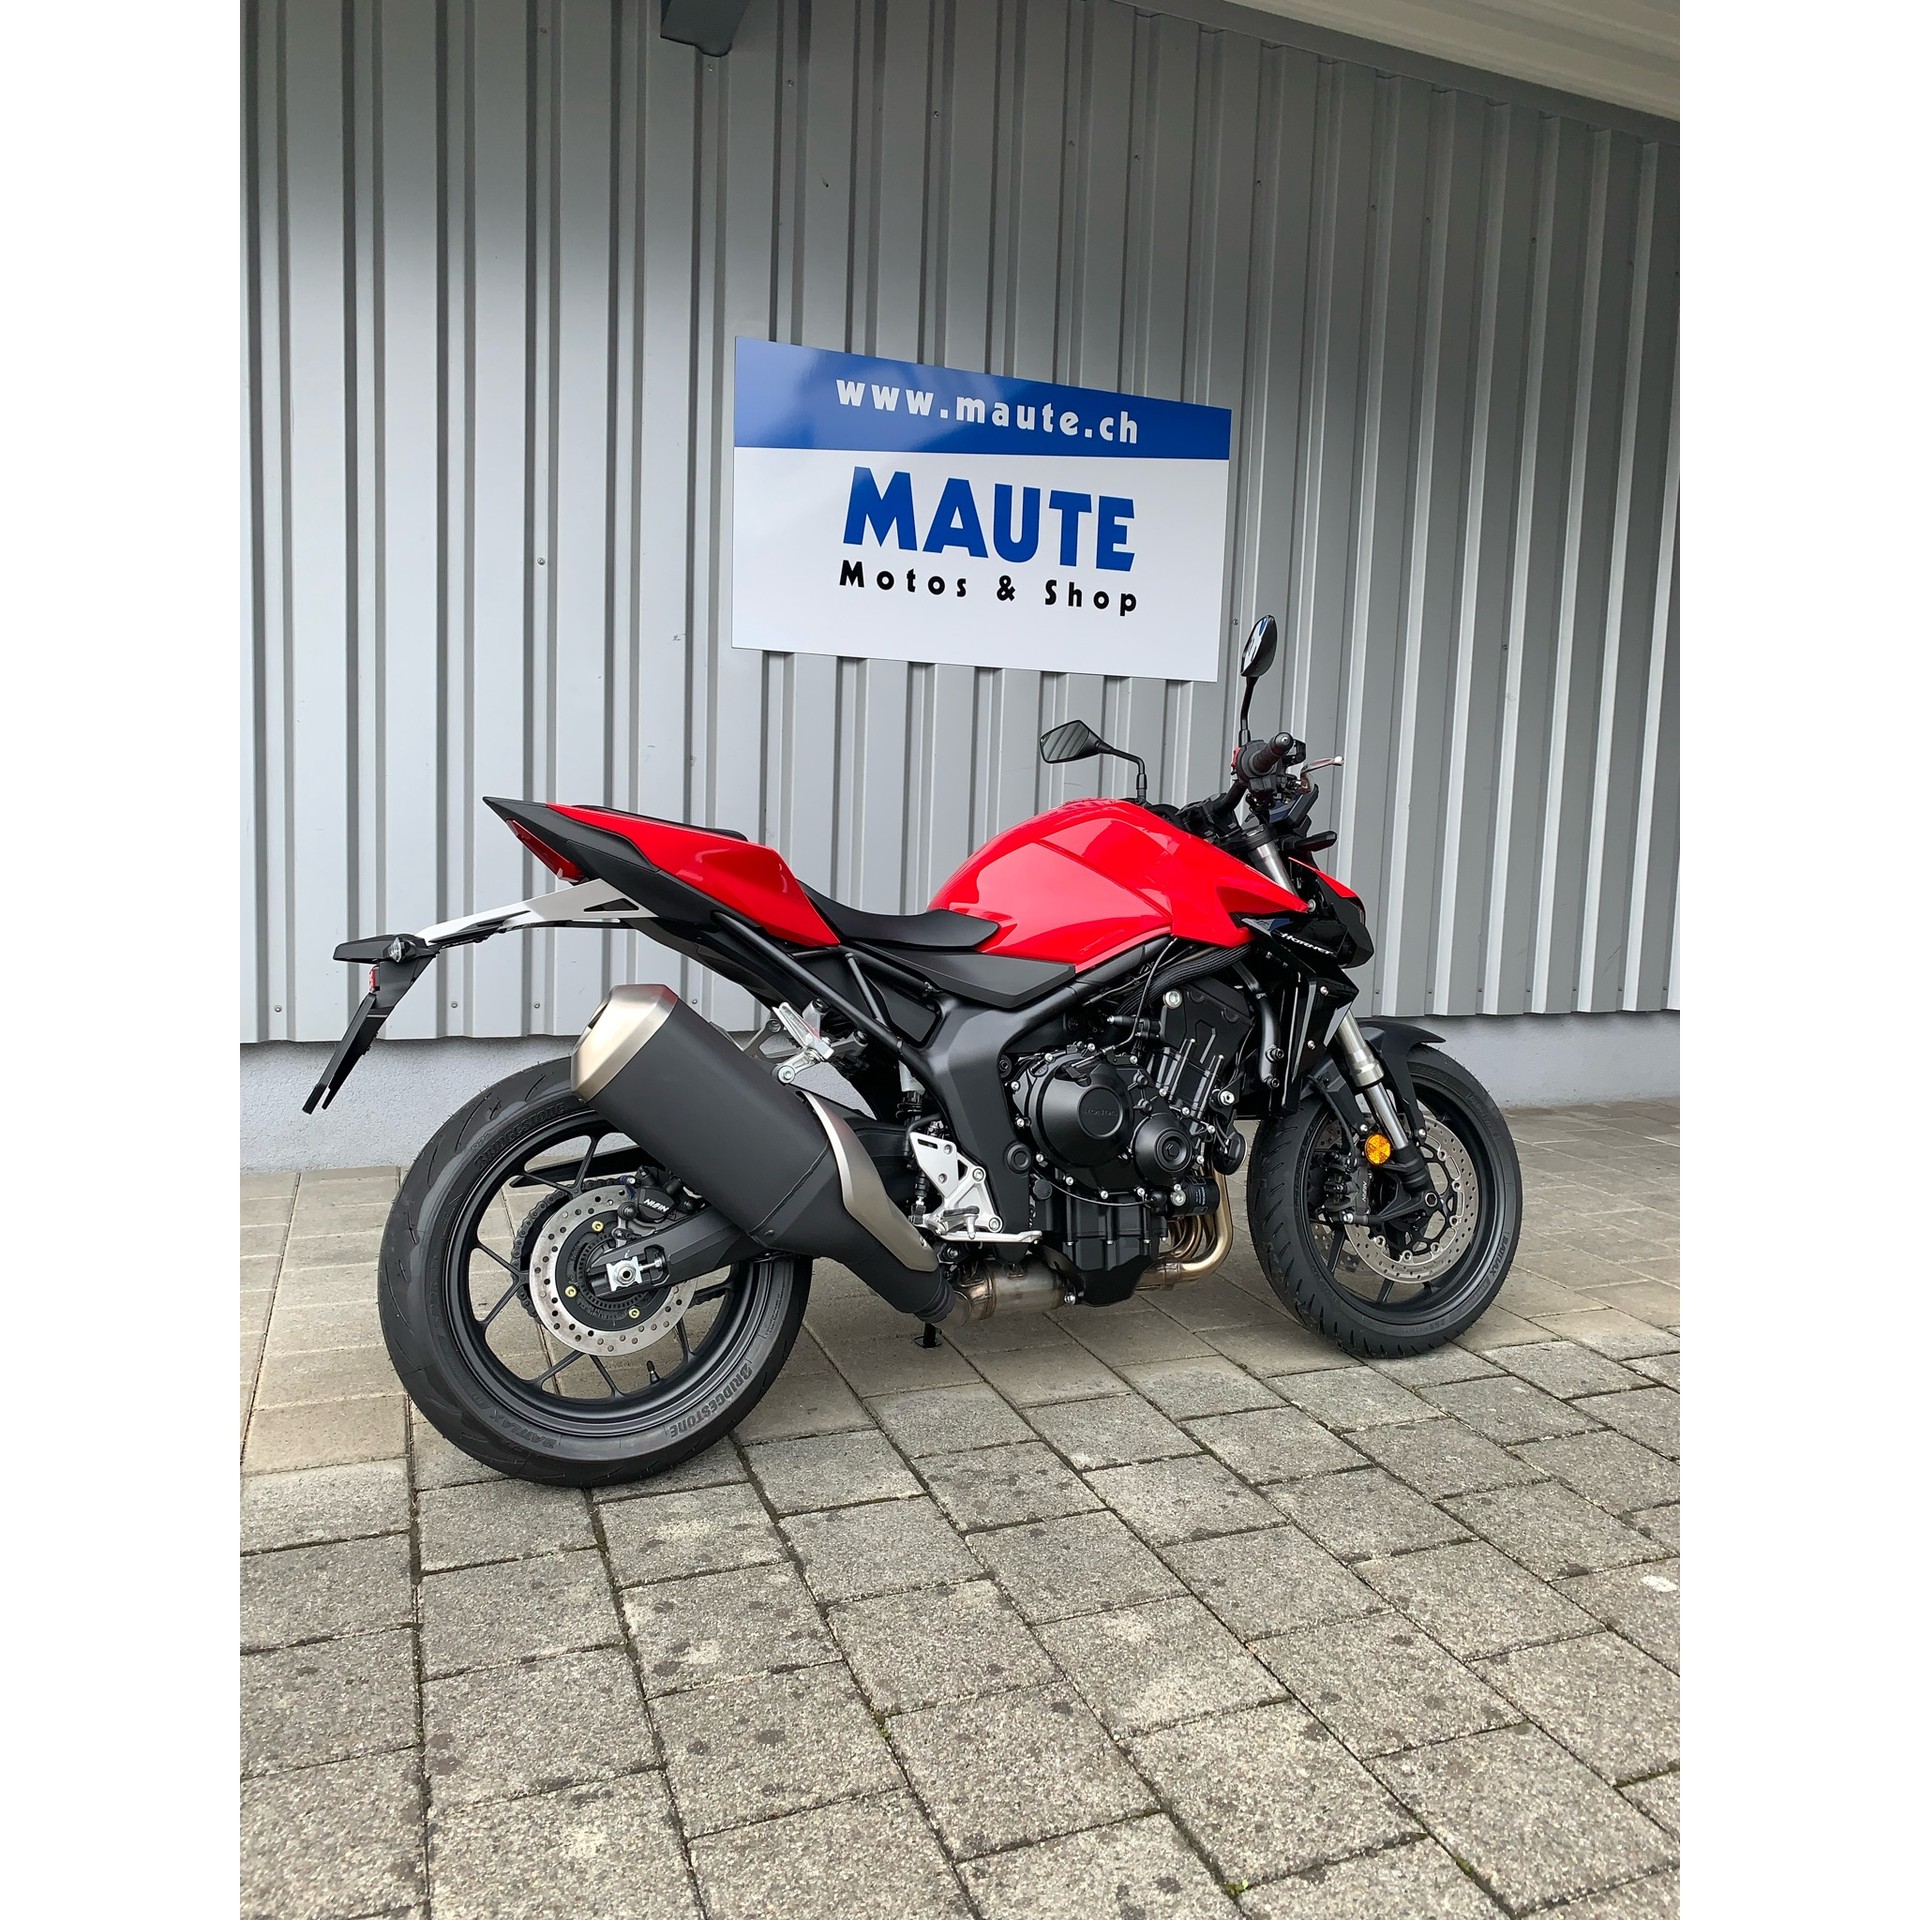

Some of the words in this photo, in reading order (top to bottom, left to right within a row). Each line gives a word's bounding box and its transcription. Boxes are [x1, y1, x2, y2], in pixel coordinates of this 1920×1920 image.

[836, 379, 1138, 444] www.maute.ch
[843, 466, 1136, 572] MAUTE
[839, 559, 967, 598] Motos
[996, 575, 1016, 602] &
[1045, 579, 1137, 617] Shop
[473, 1101, 565, 1171] BRIDGESTONE
[669, 1363, 753, 1438] BRIDGESTONE
